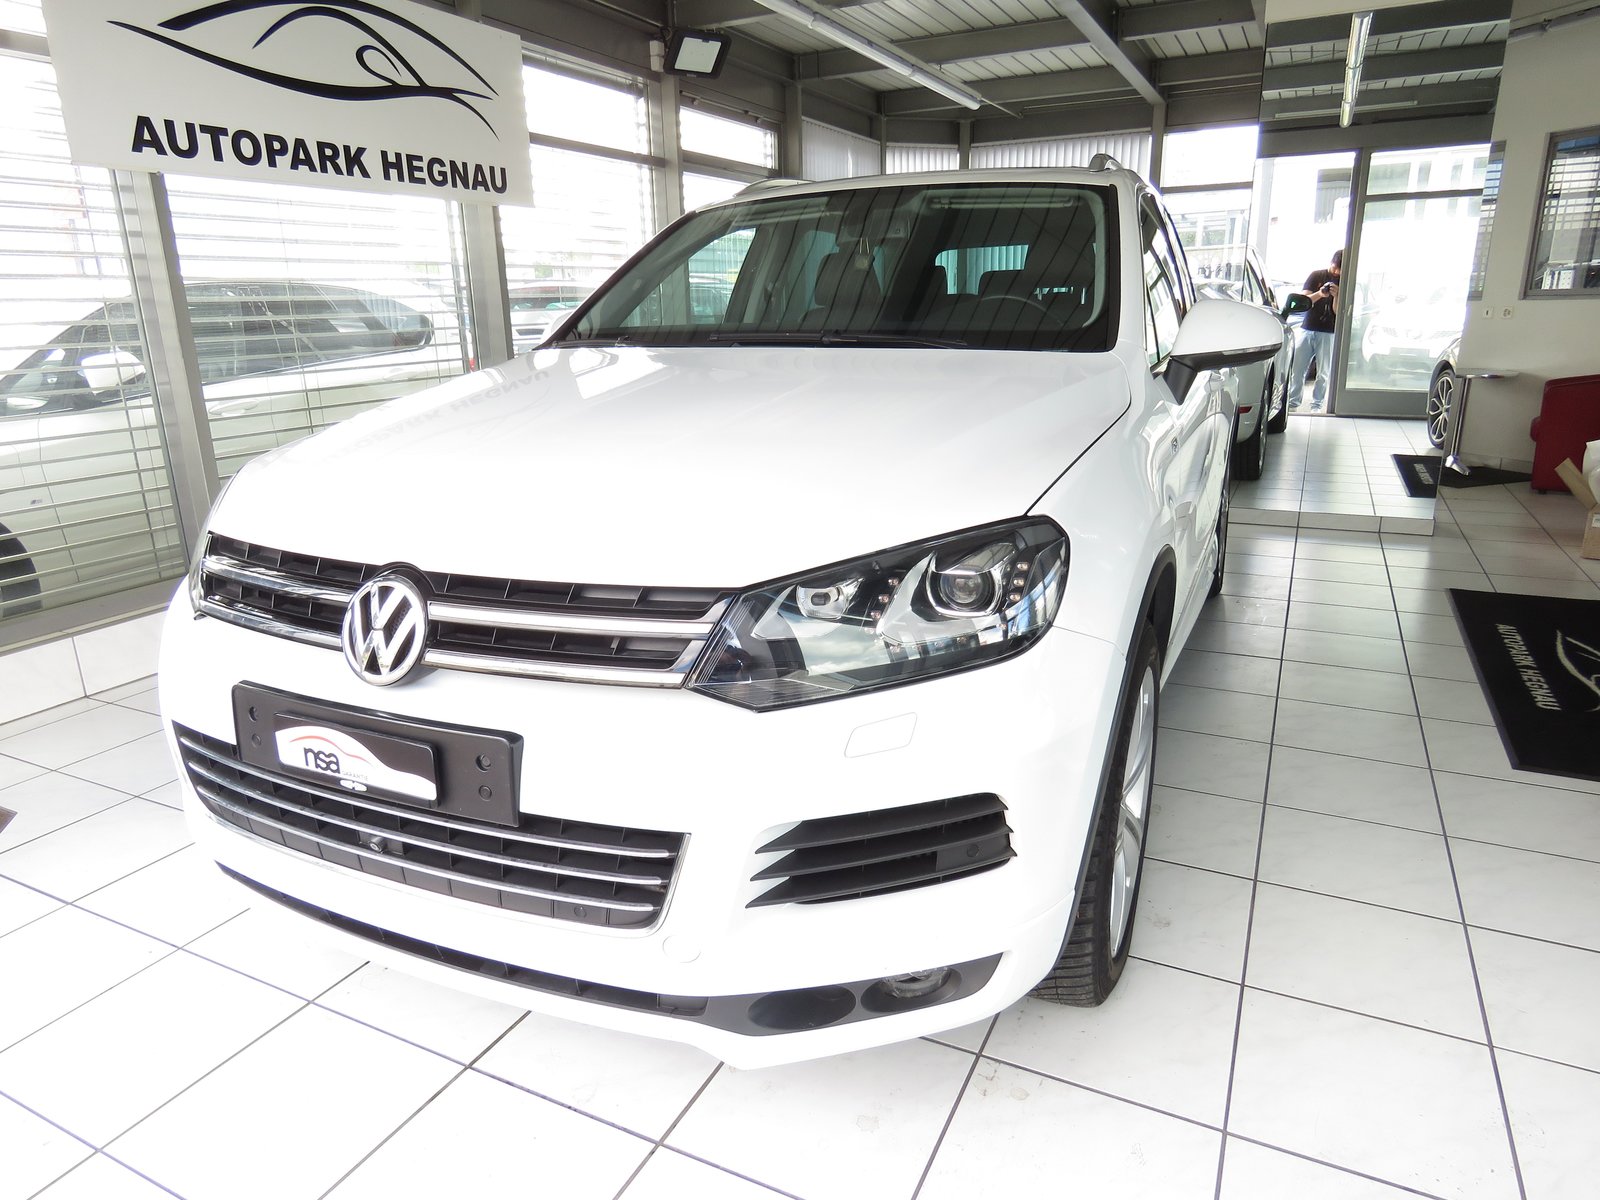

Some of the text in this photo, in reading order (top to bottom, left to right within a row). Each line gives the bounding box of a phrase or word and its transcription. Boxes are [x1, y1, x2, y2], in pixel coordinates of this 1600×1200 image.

[131, 115, 509, 194] AUTOPARK HEGNAU
[1495, 623, 1562, 711] AUTOPARK HEGNAU
[303, 747, 341, 774] nsa
